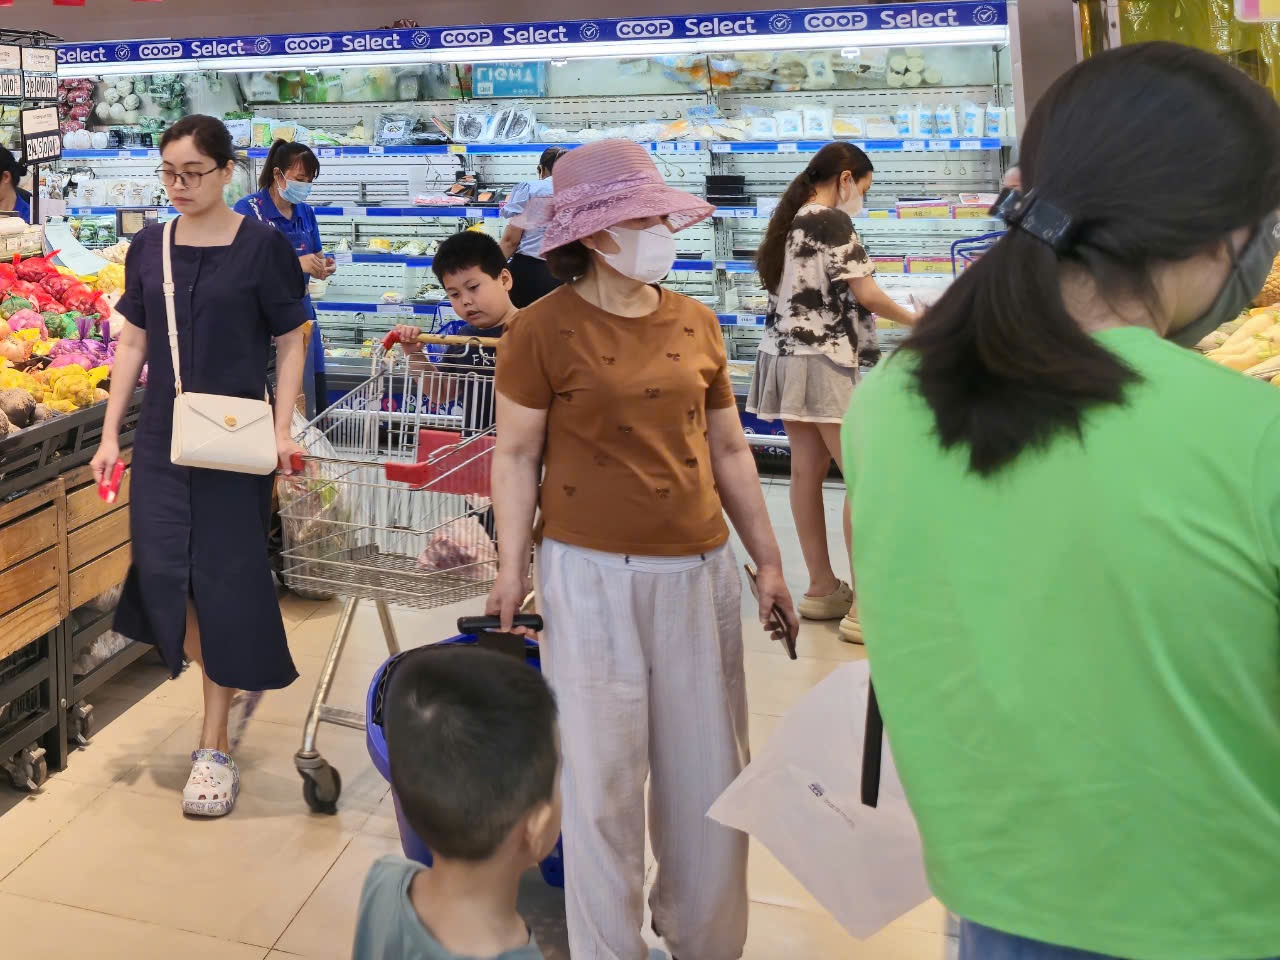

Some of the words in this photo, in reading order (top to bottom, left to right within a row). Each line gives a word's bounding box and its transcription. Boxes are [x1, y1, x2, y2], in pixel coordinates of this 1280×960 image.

[618, 21, 671, 36] COOP
[685, 16, 757, 36] Select
[806, 14, 865, 29] COOP
[880, 8, 960, 29] Select
[286, 38, 331, 52] COOP
[341, 33, 401, 51] Select
[442, 30, 491, 45] COOP
[503, 25, 569, 44] Select
[57, 46, 107, 63] Select
[140, 44, 181, 57] COOP
[191, 39, 245, 56] Select
